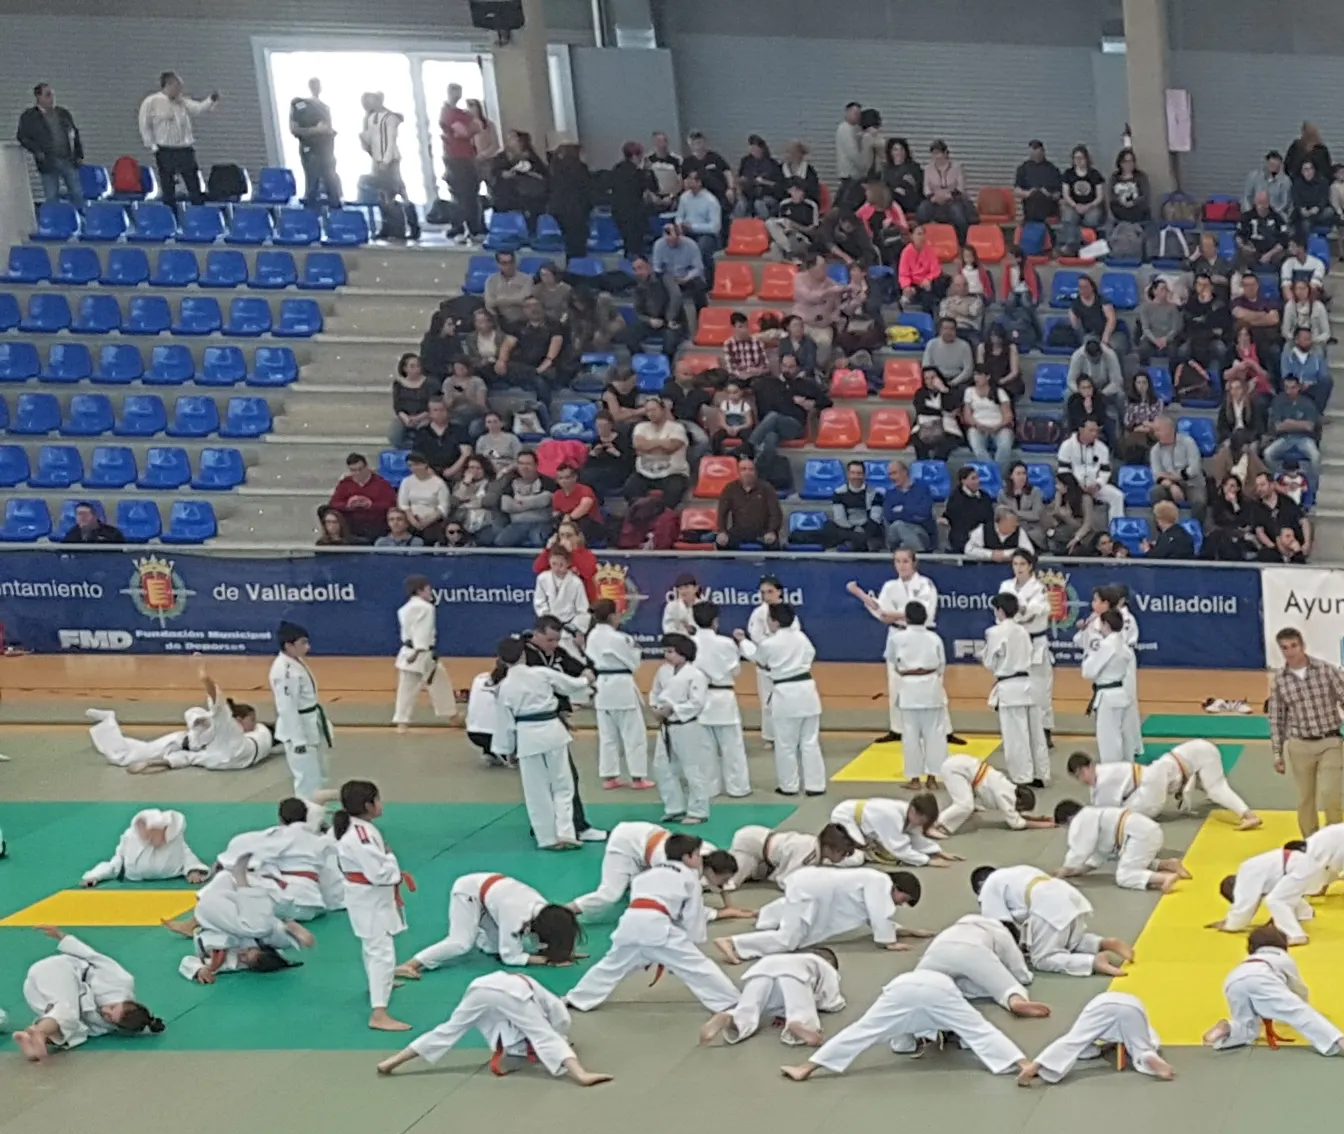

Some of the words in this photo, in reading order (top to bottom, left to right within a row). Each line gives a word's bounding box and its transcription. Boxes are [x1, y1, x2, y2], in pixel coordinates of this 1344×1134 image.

[0, 580, 103, 598] ntamiento
[213, 583, 239, 600] de
[246, 583, 356, 601] Valladolid
[431, 584, 535, 606] yuntamien
[1135, 594, 1237, 614] Valladolid
[58, 629, 133, 650] FMD
